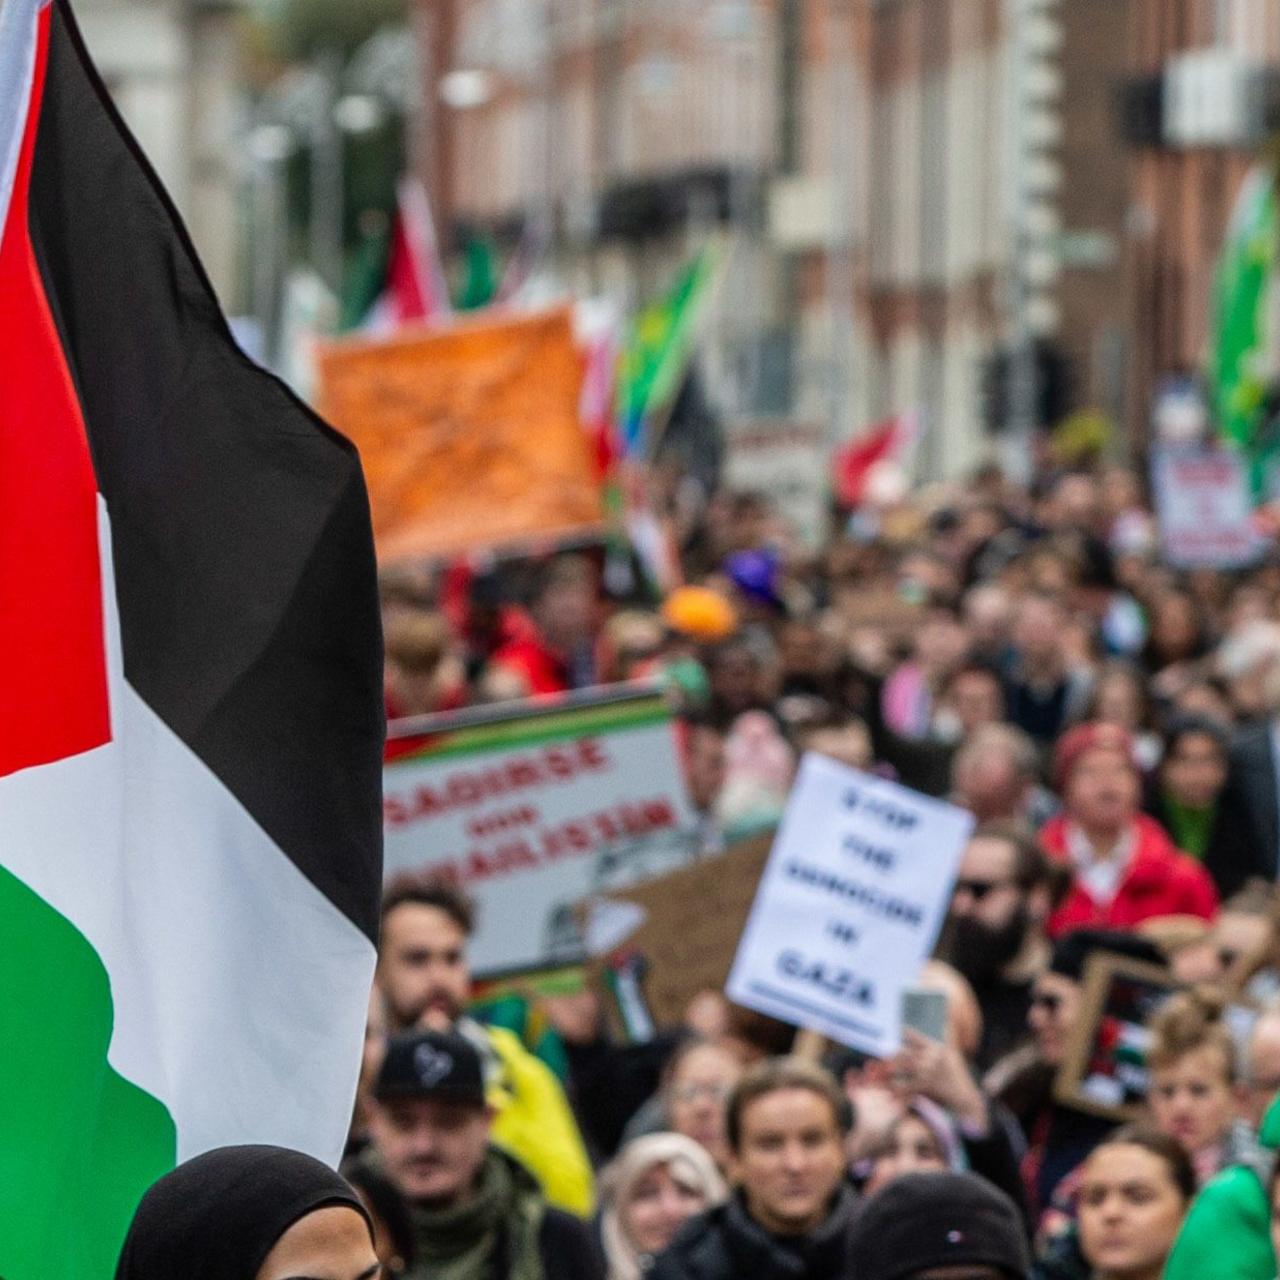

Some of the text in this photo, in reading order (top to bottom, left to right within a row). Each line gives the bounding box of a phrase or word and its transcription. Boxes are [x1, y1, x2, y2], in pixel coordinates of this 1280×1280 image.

[841, 786, 920, 831] STOP
[842, 834, 896, 871] THE
[785, 858, 923, 926] GENOCIDE
[776, 949, 876, 1005] GAZA
